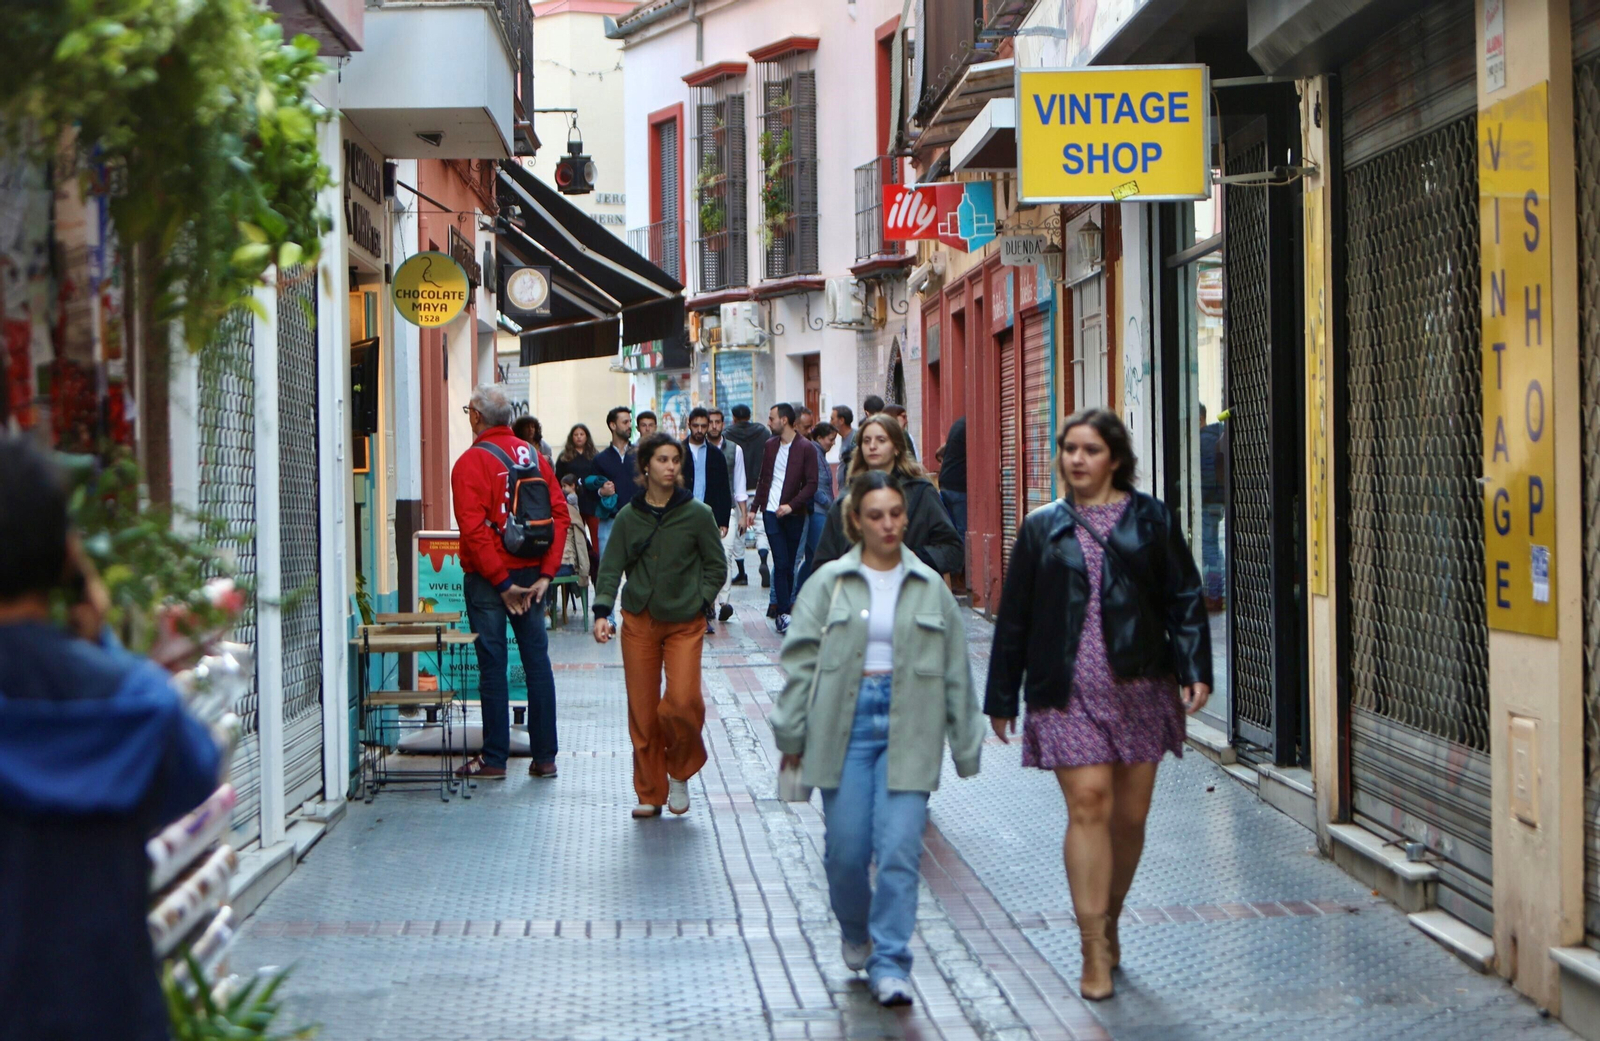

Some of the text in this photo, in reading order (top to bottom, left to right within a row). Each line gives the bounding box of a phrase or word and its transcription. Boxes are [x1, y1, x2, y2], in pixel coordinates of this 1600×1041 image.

[1032, 91, 1190, 126] VINTAGE
[1062, 141, 1163, 175] SHOP
[887, 190, 937, 237] illy
[395, 288, 465, 301] CHOCOLATE
[411, 302, 448, 313] MAYA
[419, 314, 440, 322] 1528
[1487, 122, 1511, 609] VINTAGE
[1524, 188, 1545, 537] SHOP
[429, 583, 462, 591] VIVE LA
